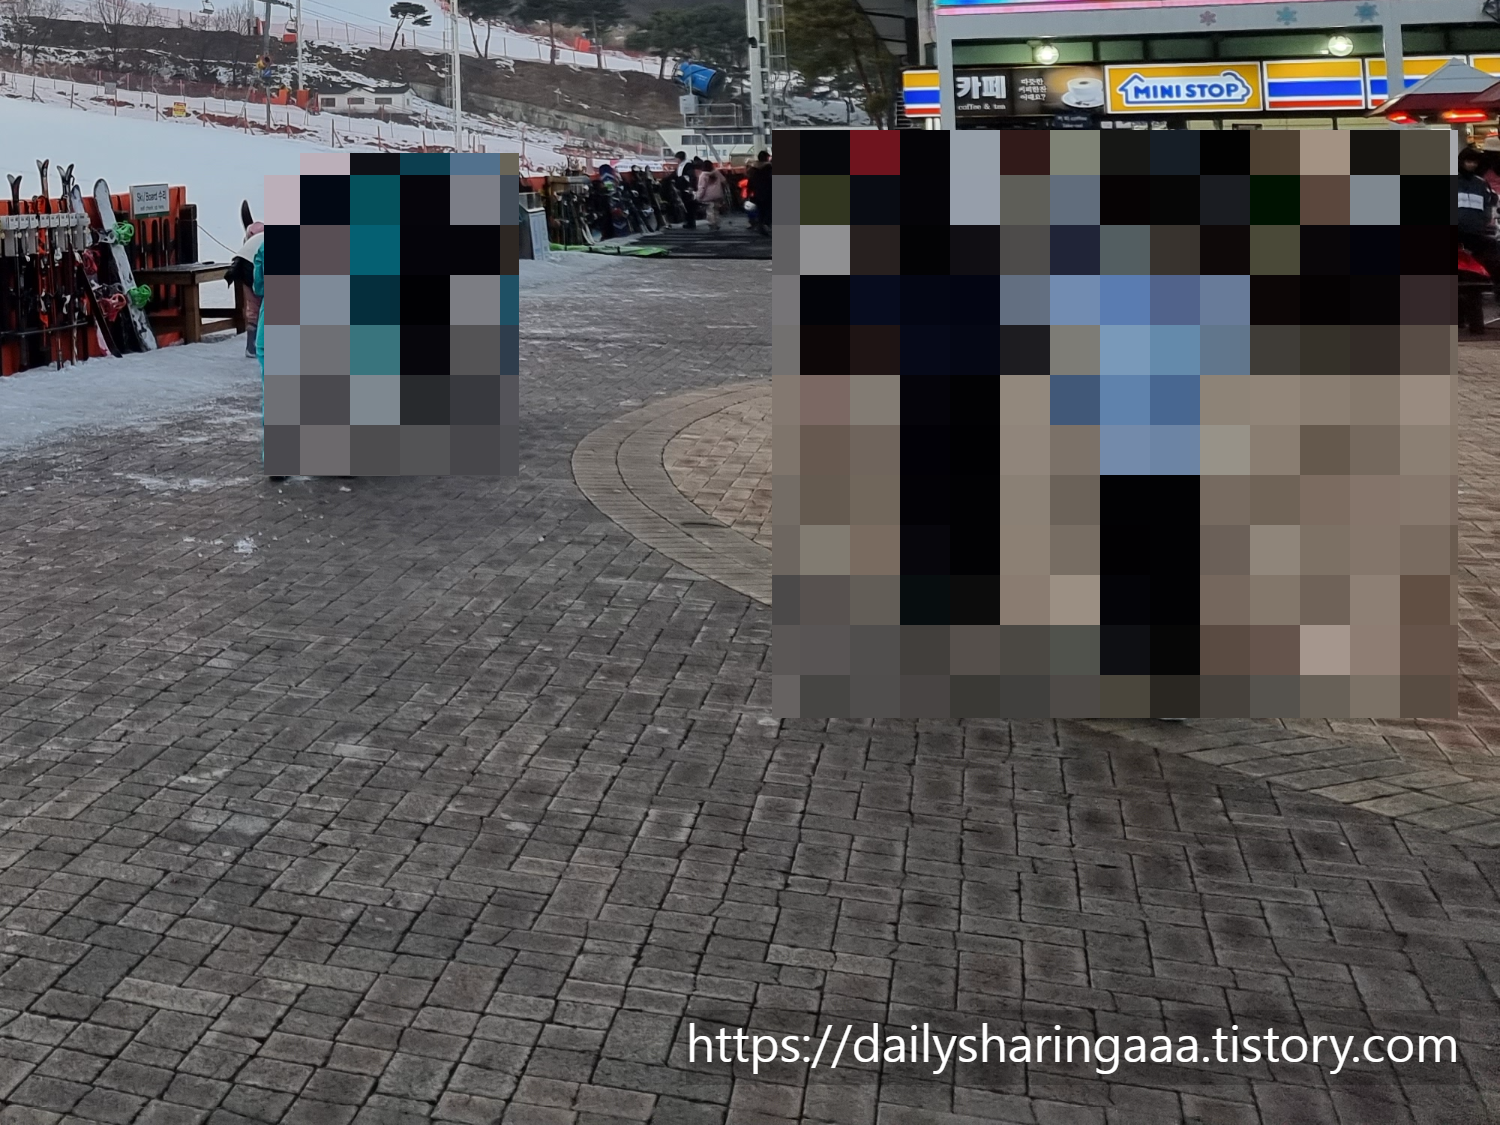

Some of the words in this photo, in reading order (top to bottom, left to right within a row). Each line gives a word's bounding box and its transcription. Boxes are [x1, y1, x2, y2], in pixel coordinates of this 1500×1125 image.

[955, 75, 1007, 100] 카페
[957, 103, 982, 111] coffee
[136, 192, 158, 202] Ski/Board
